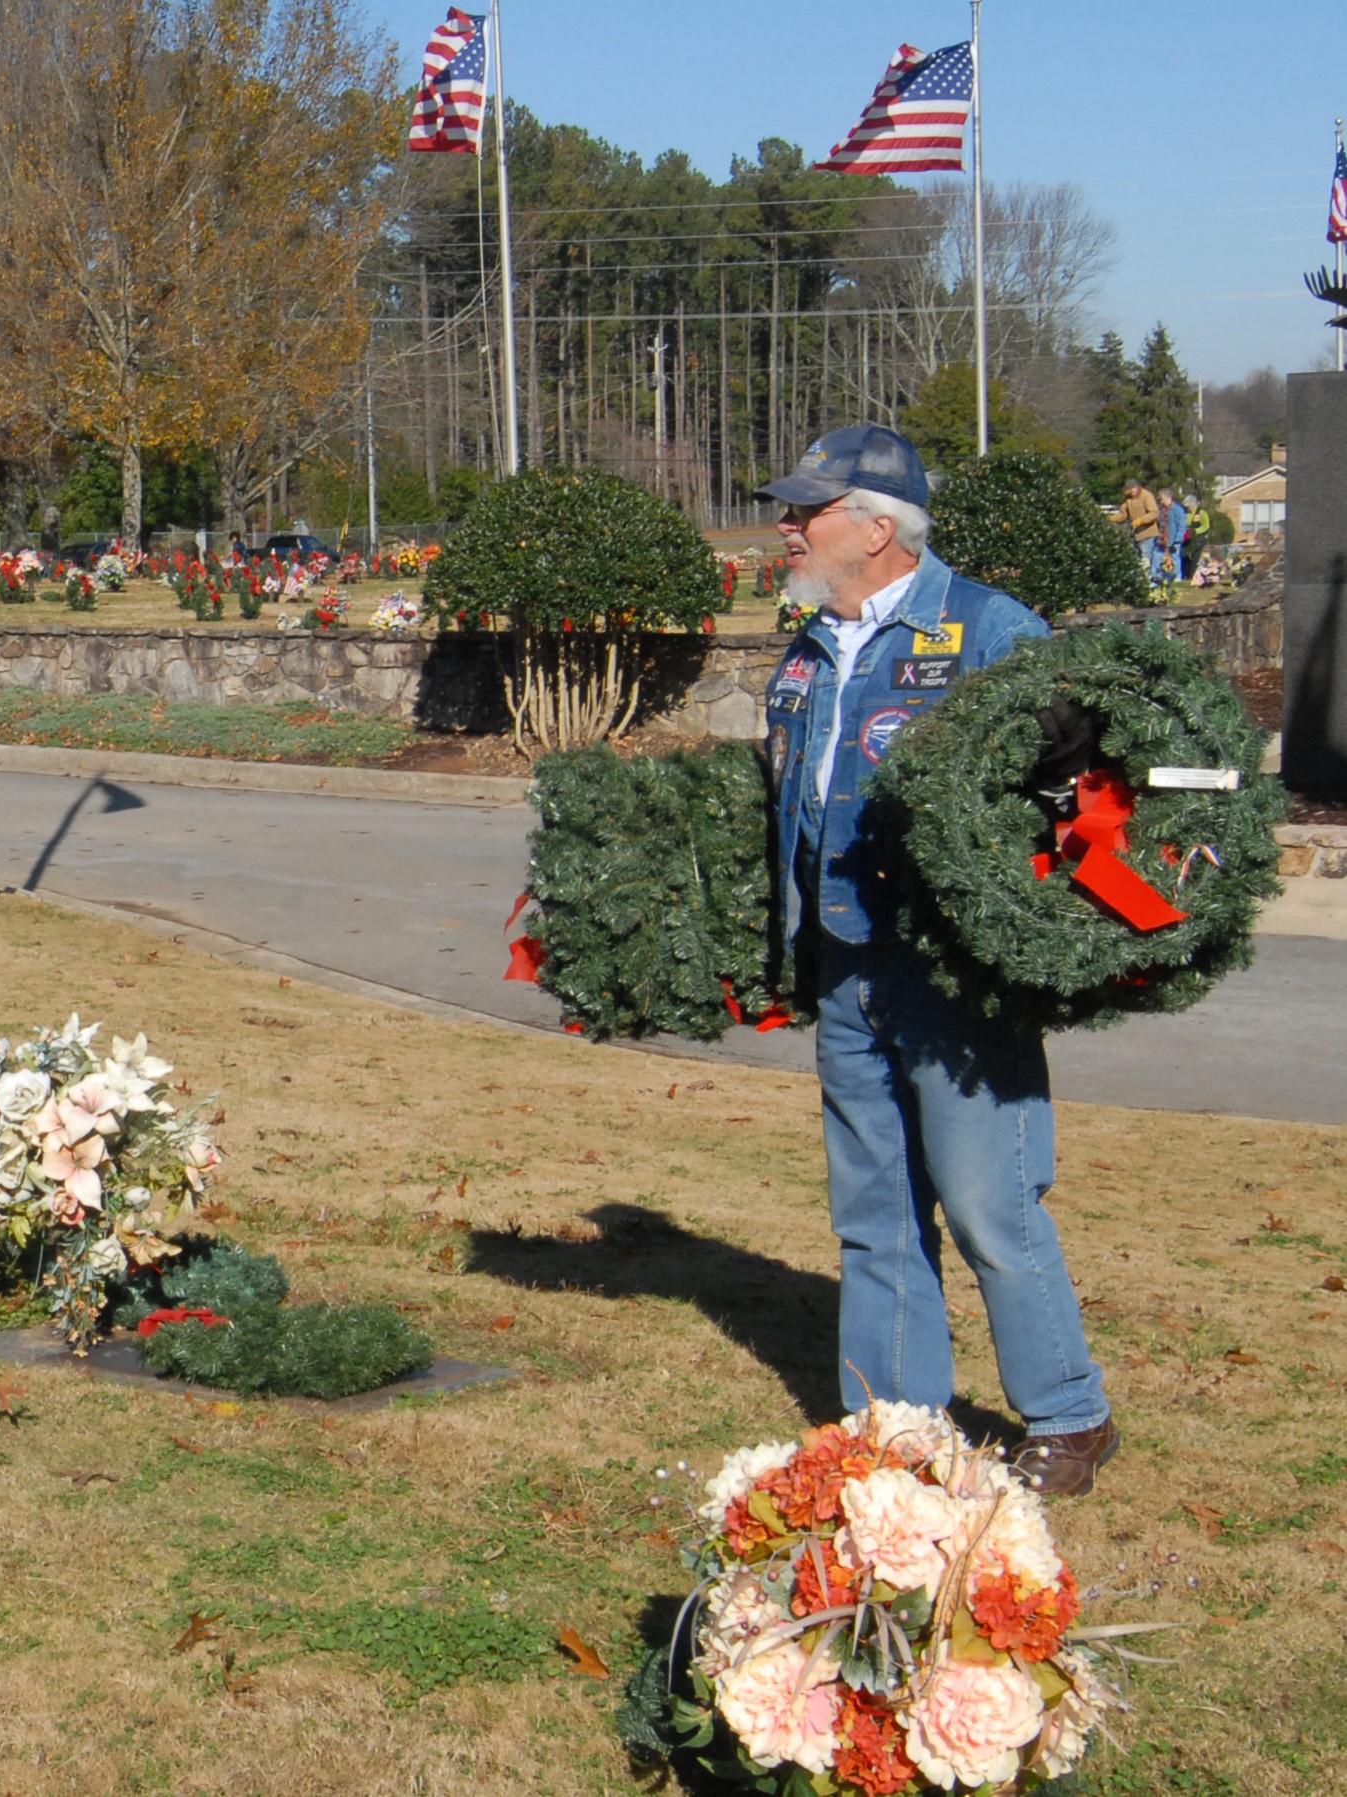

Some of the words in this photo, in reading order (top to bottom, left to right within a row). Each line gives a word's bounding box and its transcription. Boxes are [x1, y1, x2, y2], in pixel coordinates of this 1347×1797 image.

[919, 661, 952, 670] SUPPORT
[927, 670, 942, 678] OUR
[920, 678, 948, 687] TROOPS
